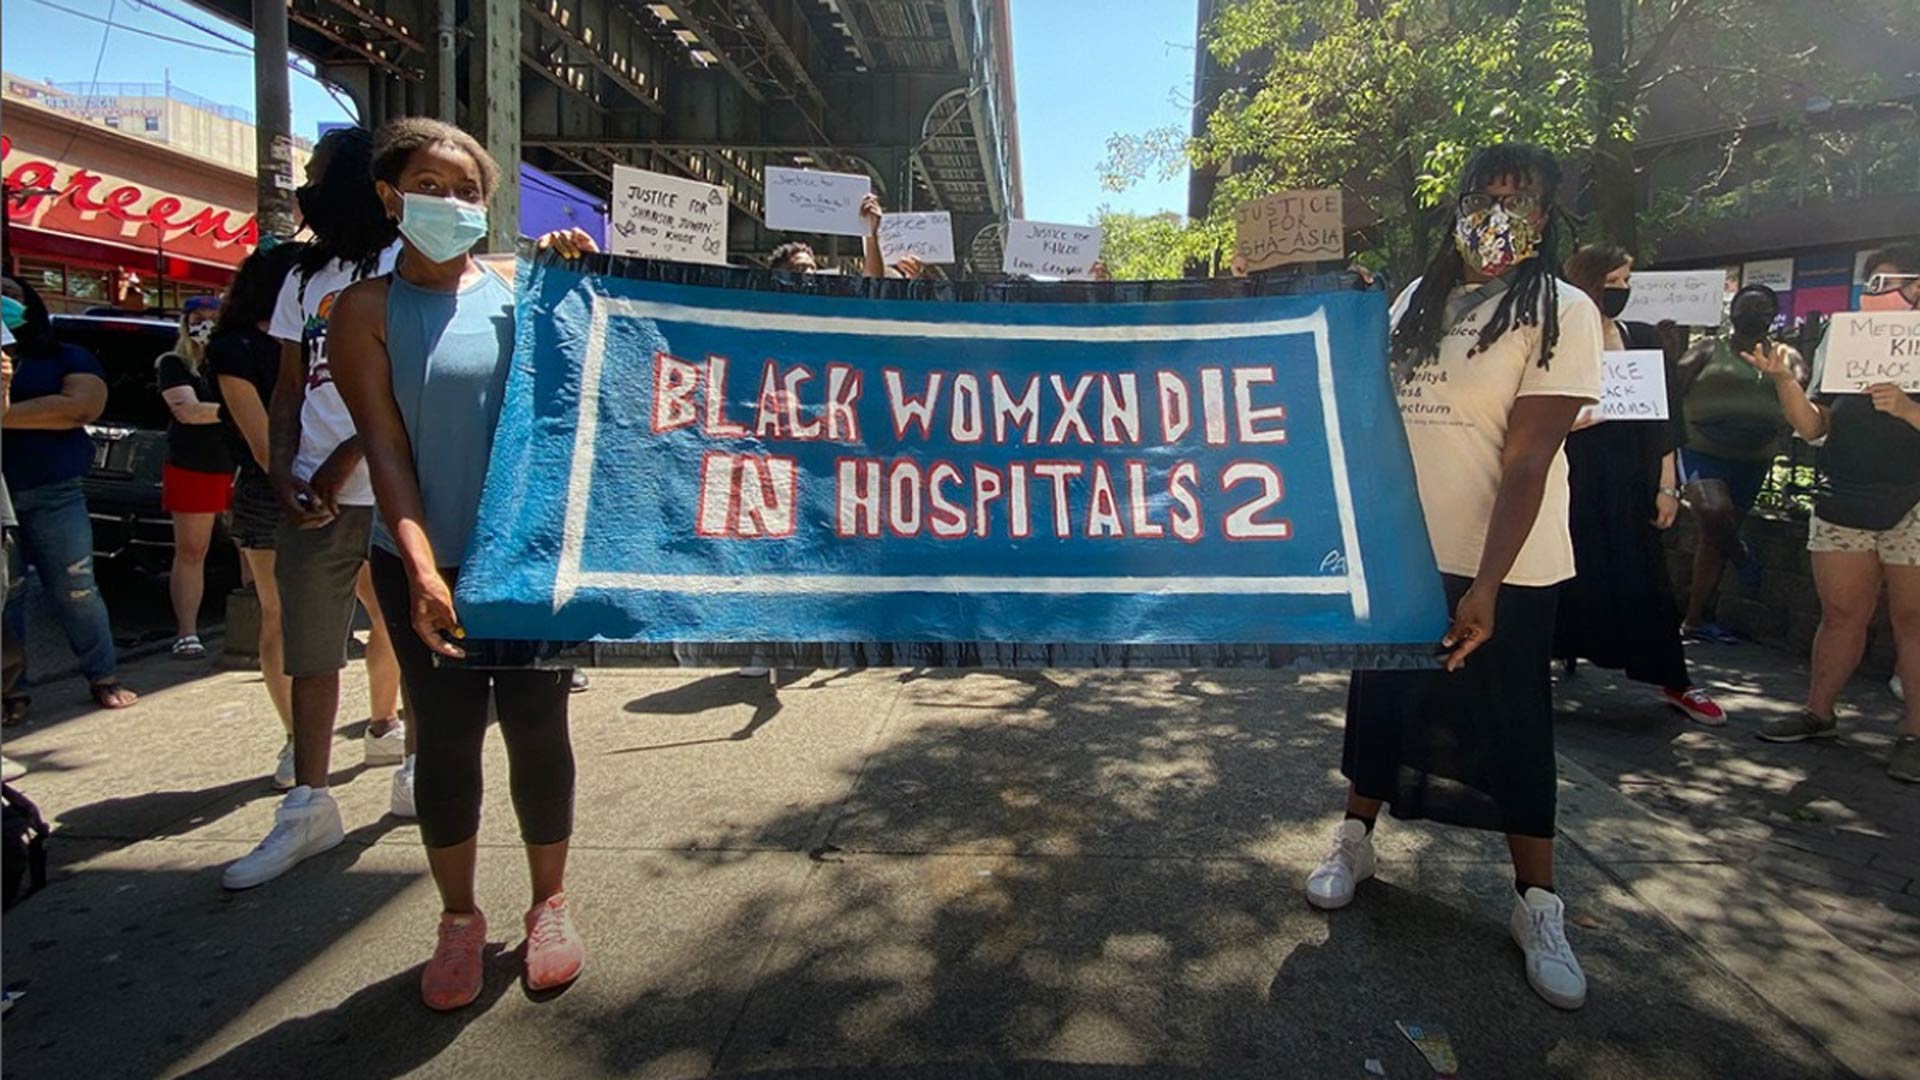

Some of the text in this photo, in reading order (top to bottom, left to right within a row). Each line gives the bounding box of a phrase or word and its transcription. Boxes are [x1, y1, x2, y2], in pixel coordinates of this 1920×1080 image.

[1, 134, 259, 246] greens
[627, 186, 708, 216] JUSTICE FOR
[1238, 195, 1338, 225] JUSTICE
[1267, 214, 1310, 234] FOR
[1601, 360, 1645, 380] ICE
[1846, 360, 1910, 379] BLACK
[652, 351, 1286, 446] BLACK WOMXN DIE
[1401, 402, 1451, 414] ectrum
[695, 450, 1292, 542] IN HOSPITALS 2
